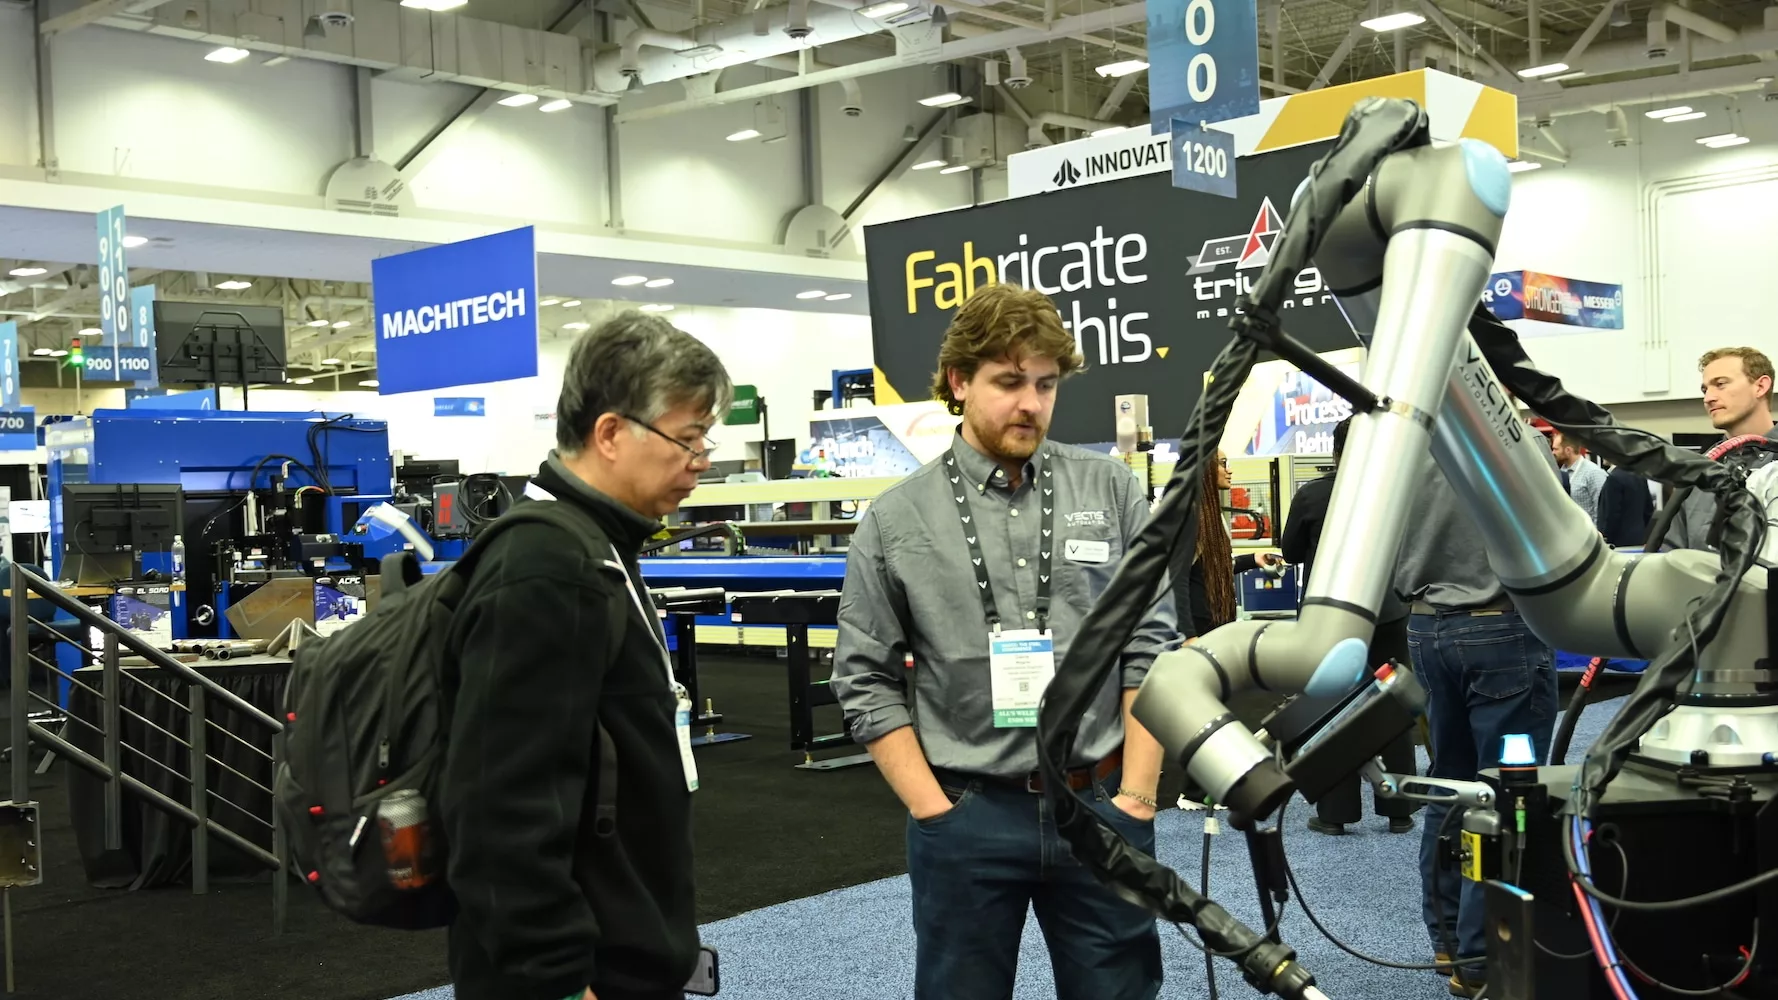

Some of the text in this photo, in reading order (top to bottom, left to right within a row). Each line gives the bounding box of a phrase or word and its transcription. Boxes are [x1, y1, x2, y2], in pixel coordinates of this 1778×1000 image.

[1183, 141, 1228, 178] 1200
[906, 225, 1148, 314] Fabricate
[1215, 246, 1232, 256] EST.
[100, 237, 111, 320] 900
[114, 217, 127, 331] 1100
[382, 288, 526, 339] MACHITECH
[1583, 295, 1615, 310] MESSER
[4, 339, 13, 395] 700
[86, 358, 112, 371] 900
[120, 358, 149, 371] 1100
[1459, 365, 1511, 446] AUTOMATION
[1467, 341, 1523, 443] VECTIS
[0, 417, 24, 429] 700
[1285, 398, 1352, 426] Process
[1064, 511, 1104, 521] VECTIS
